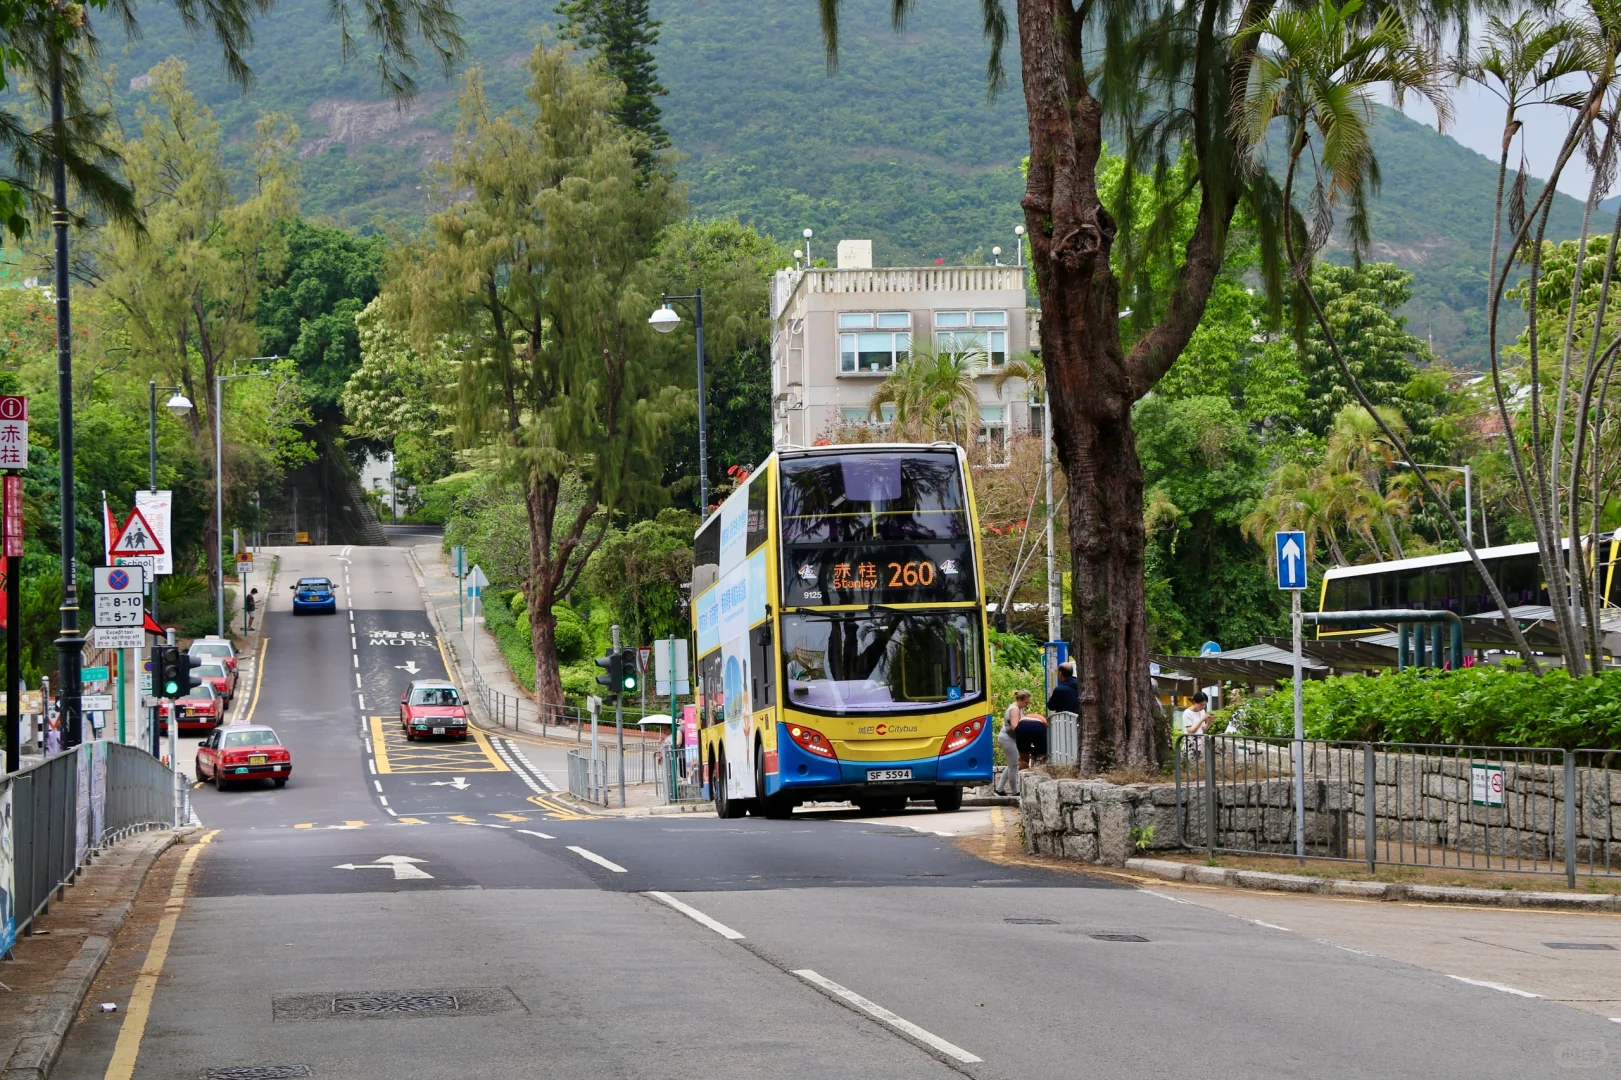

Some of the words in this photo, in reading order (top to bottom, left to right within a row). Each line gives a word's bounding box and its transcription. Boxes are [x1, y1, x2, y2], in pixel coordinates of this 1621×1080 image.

[1, 424, 21, 463] 赤柱
[834, 562, 876, 579] 赤柱
[888, 561, 933, 587] 260
[832, 578, 877, 589] Stanley
[803, 591, 822, 599] 9125
[113, 597, 141, 607] 8-10
[114, 612, 137, 622] 5-7
[888, 725, 918, 733] Citybus
[870, 771, 881, 780] SF
[885, 770, 909, 779] 5594
